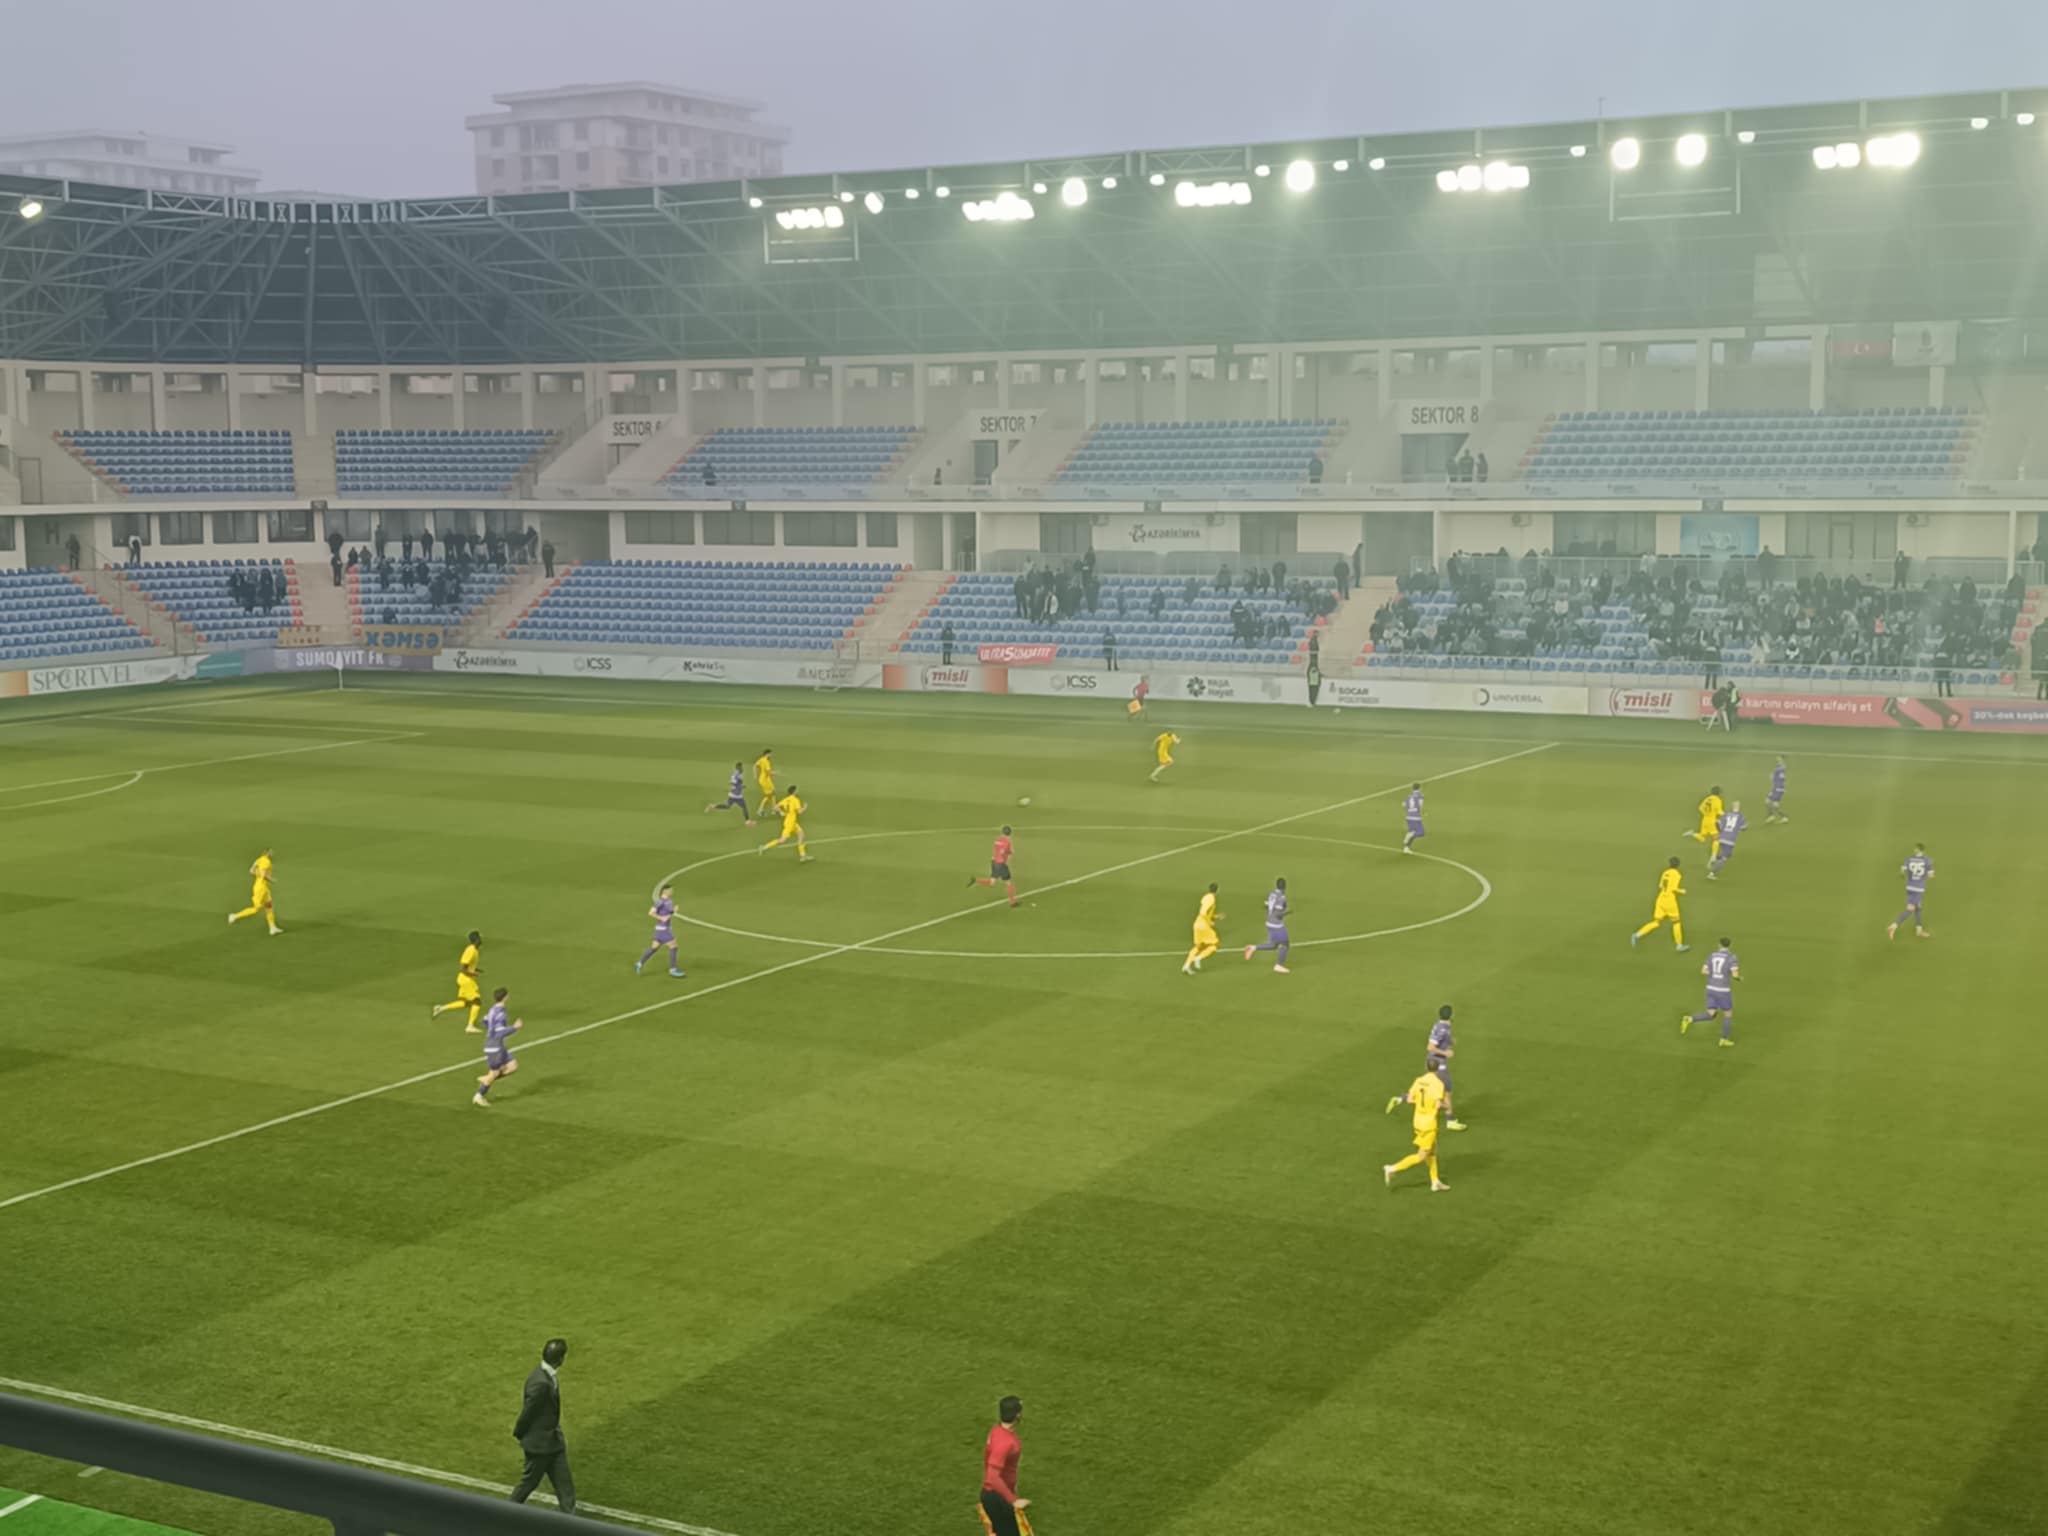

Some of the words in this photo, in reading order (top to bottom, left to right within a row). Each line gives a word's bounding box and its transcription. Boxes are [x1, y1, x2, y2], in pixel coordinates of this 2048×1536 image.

[1411, 405, 1465, 424] SEKTOR
[1471, 405, 1479, 423] 8
[613, 421, 653, 436] SEKTOR
[980, 416, 1026, 433] SEKTOR
[366, 631, 439, 648] XƏMSƏ
[587, 657, 612, 670] ICSS
[931, 669, 969, 682] misli
[1066, 675, 1097, 688] ICSS
[1338, 687, 1369, 696] SOCAR
[1492, 694, 1543, 704] UNIVERSAL
[1623, 691, 1673, 707] misli
[1784, 700, 1820, 712] onlayn
[1860, 702, 1873, 712] et
[1909, 861, 1925, 876] 95
[1712, 957, 1726, 974] 17
